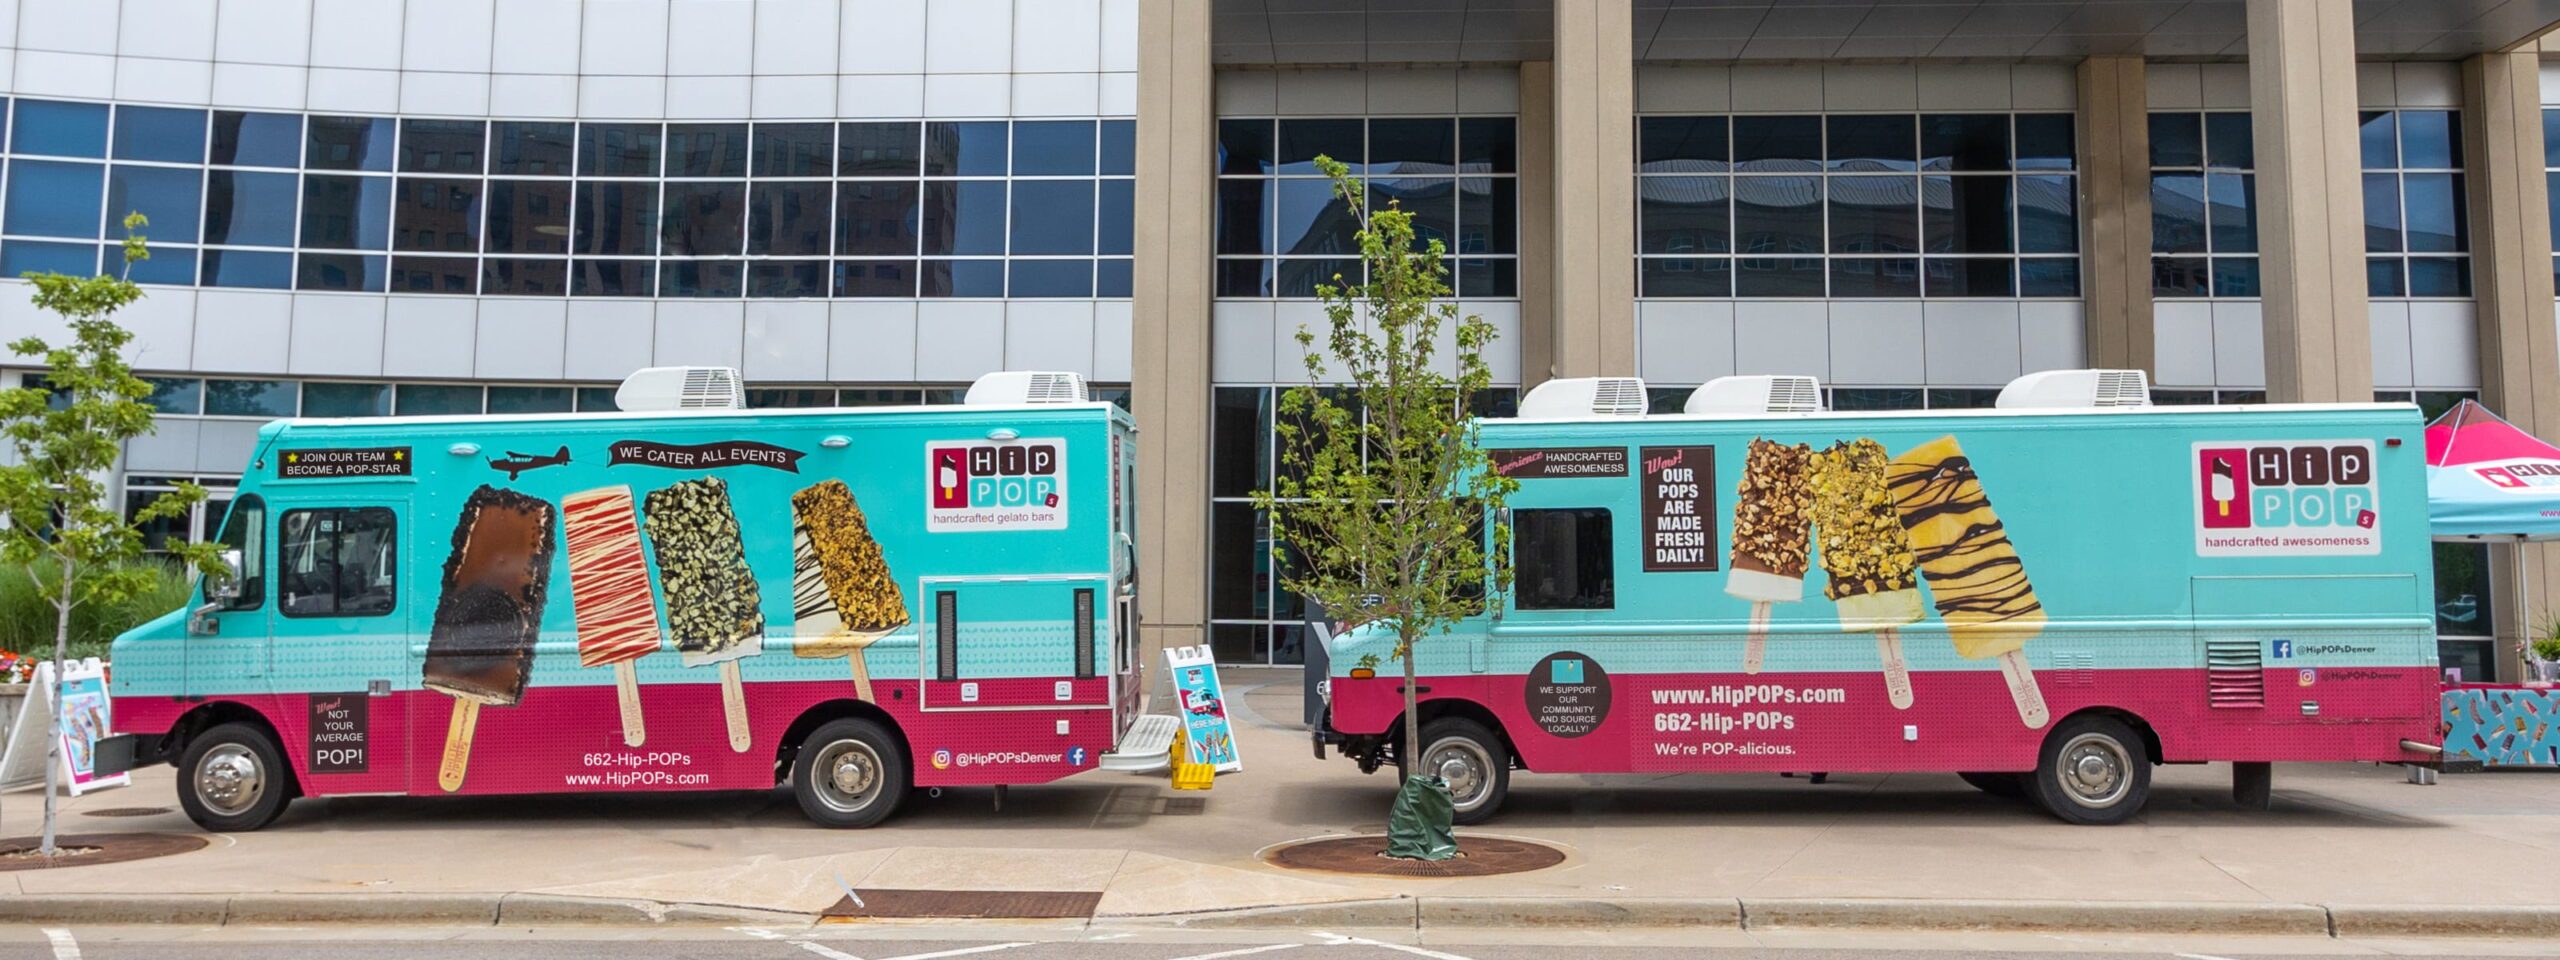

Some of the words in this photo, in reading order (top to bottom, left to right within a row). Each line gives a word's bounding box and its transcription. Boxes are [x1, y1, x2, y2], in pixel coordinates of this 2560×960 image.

[301, 452, 326, 463] JOIN
[329, 452, 353, 462] OUR
[355, 451, 385, 461] TEAM
[619, 446, 642, 458] WE
[647, 449, 694, 465] CATER
[701, 449, 727, 463] ALL
[731, 448, 786, 463] EVENTS
[975, 451, 1050, 472] Hip
[1644, 449, 1682, 474] Wow!
[286, 465, 333, 475] BECOME
[335, 465, 343, 474] A
[346, 464, 401, 474] POP-STAR
[1492, 451, 1544, 476] xperience
[1545, 452, 1622, 462] HANDCRAFTED
[1543, 463, 1625, 474] AWESOMENESS
[2258, 453, 2361, 481] Hip
[1662, 468, 1694, 483] OUR
[1658, 484, 1699, 499] POPS
[1663, 500, 1695, 514] ARE
[933, 513, 994, 524] handcrafted
[997, 512, 1029, 526] gelato
[1032, 511, 1054, 522] bars
[1657, 516, 1702, 531] MADE
[1655, 532, 1704, 547] FRESH
[2205, 536, 2279, 548] handcrafted
[2282, 536, 2370, 546] awesomeness
[1656, 548, 1704, 563] DAILY!
[2296, 645, 2376, 655] @HipPOPsDenver
[1539, 686, 1554, 694] WE
[1555, 686, 1597, 694] SUPPORT
[1651, 684, 1846, 707] www.HipPOPs.com
[1558, 695, 1578, 704] OUR
[328, 710, 350, 719] NOT
[1542, 705, 1594, 714] COMMUNITY
[324, 721, 354, 731] YOUR
[1539, 715, 1558, 723] AND
[1560, 715, 1597, 723] SOURCE
[1654, 711, 1795, 734] 662-Hip-POPs
[1548, 725, 1589, 733] LOCALLY!
[314, 732, 364, 742] AVERAGE
[1654, 742, 1698, 755] We're
[1702, 741, 1796, 755] POP-alicious.
[316, 748, 363, 765] POP!
[583, 752, 691, 768] 662-Hip-POPs
[955, 751, 1062, 767] @HipPOPsDenver
[565, 771, 710, 787] www.HipPOPs.com
